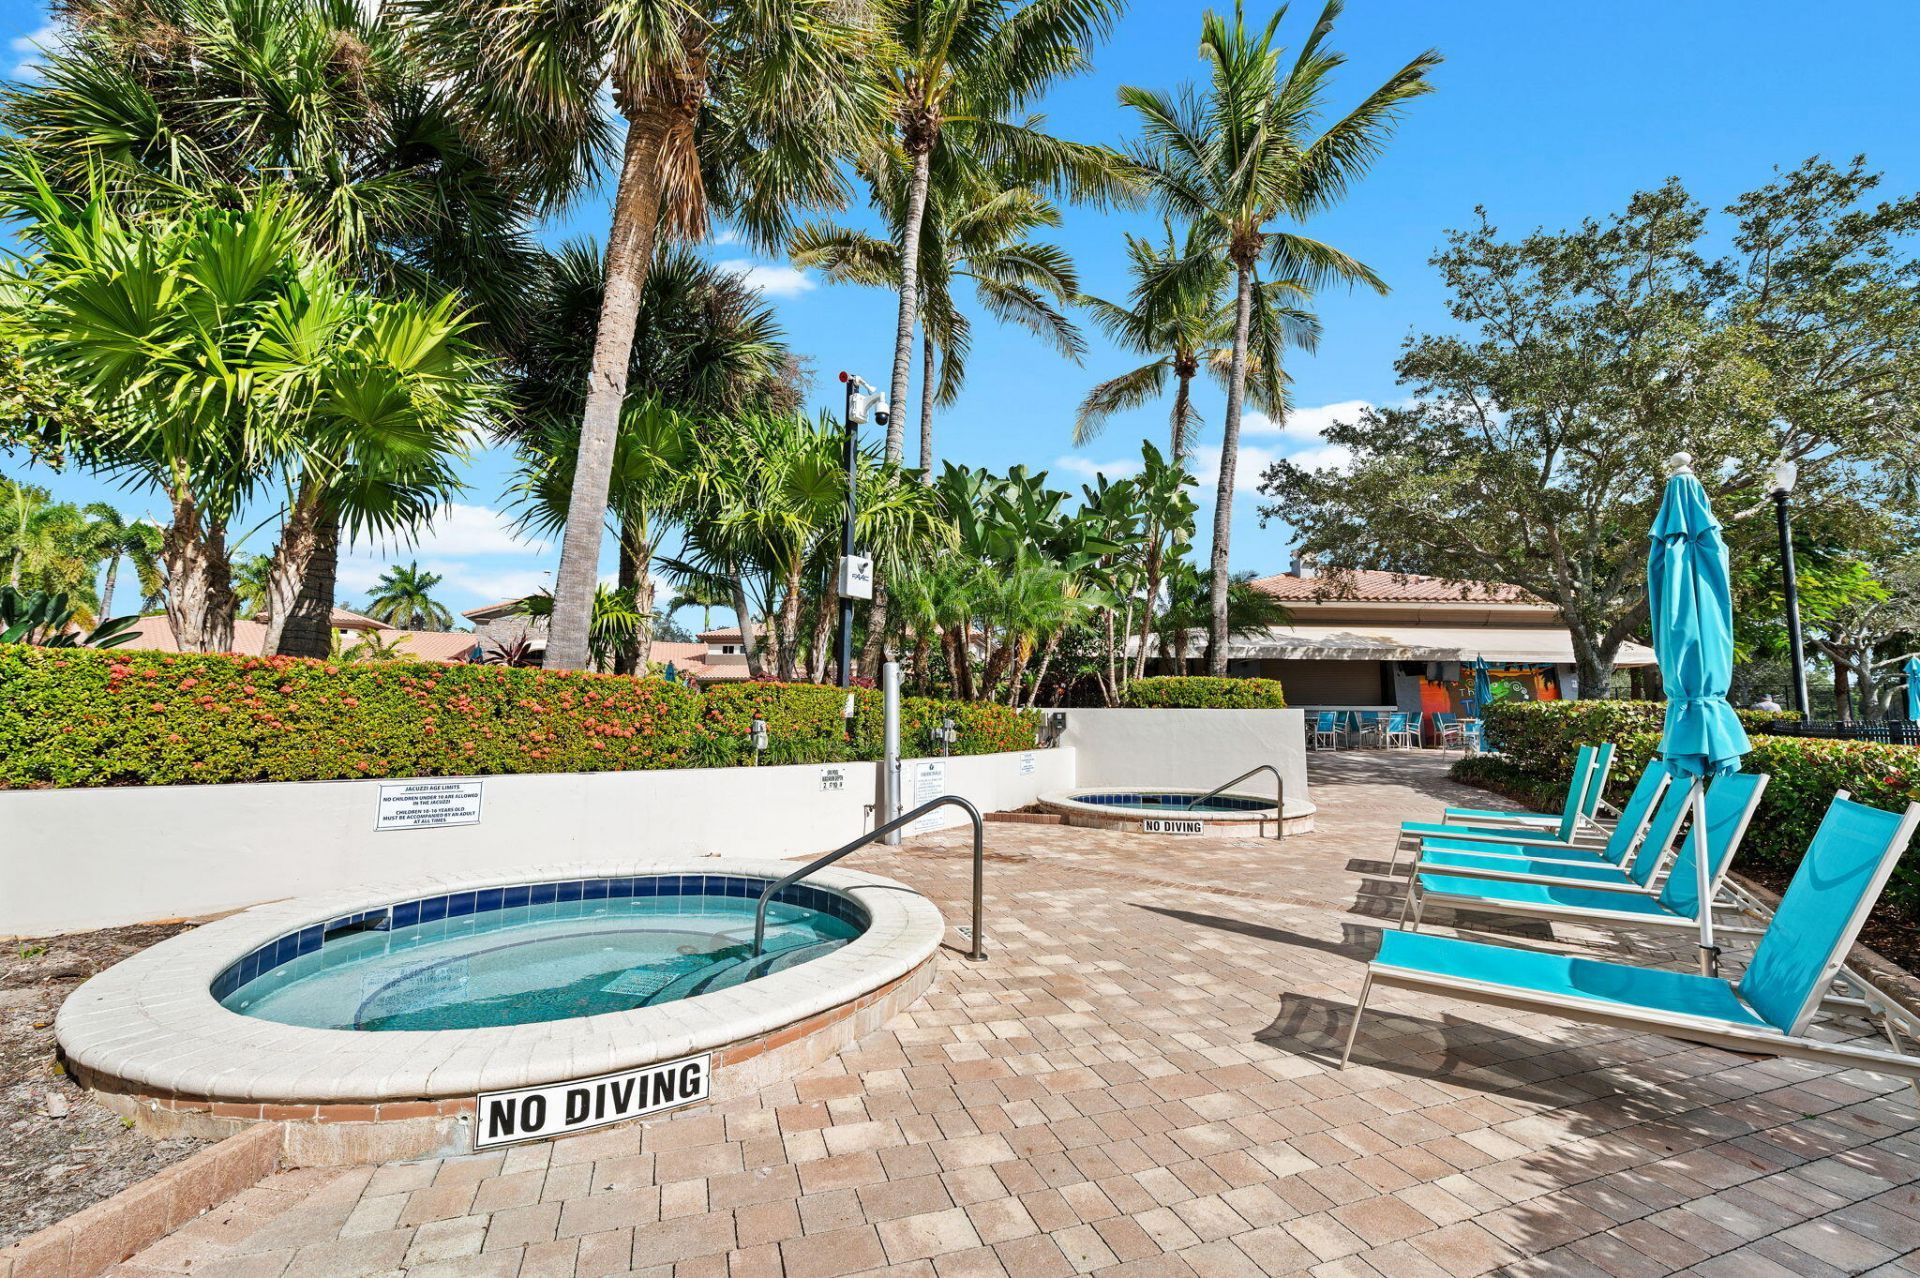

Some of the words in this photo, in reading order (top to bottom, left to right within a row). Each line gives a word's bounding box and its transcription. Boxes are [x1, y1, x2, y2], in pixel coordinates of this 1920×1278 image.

[1146, 821, 1160, 832] NO
[1164, 822, 1200, 832] DIVING
[488, 1094, 547, 1139] NO
[565, 1062, 700, 1126] DIVING
